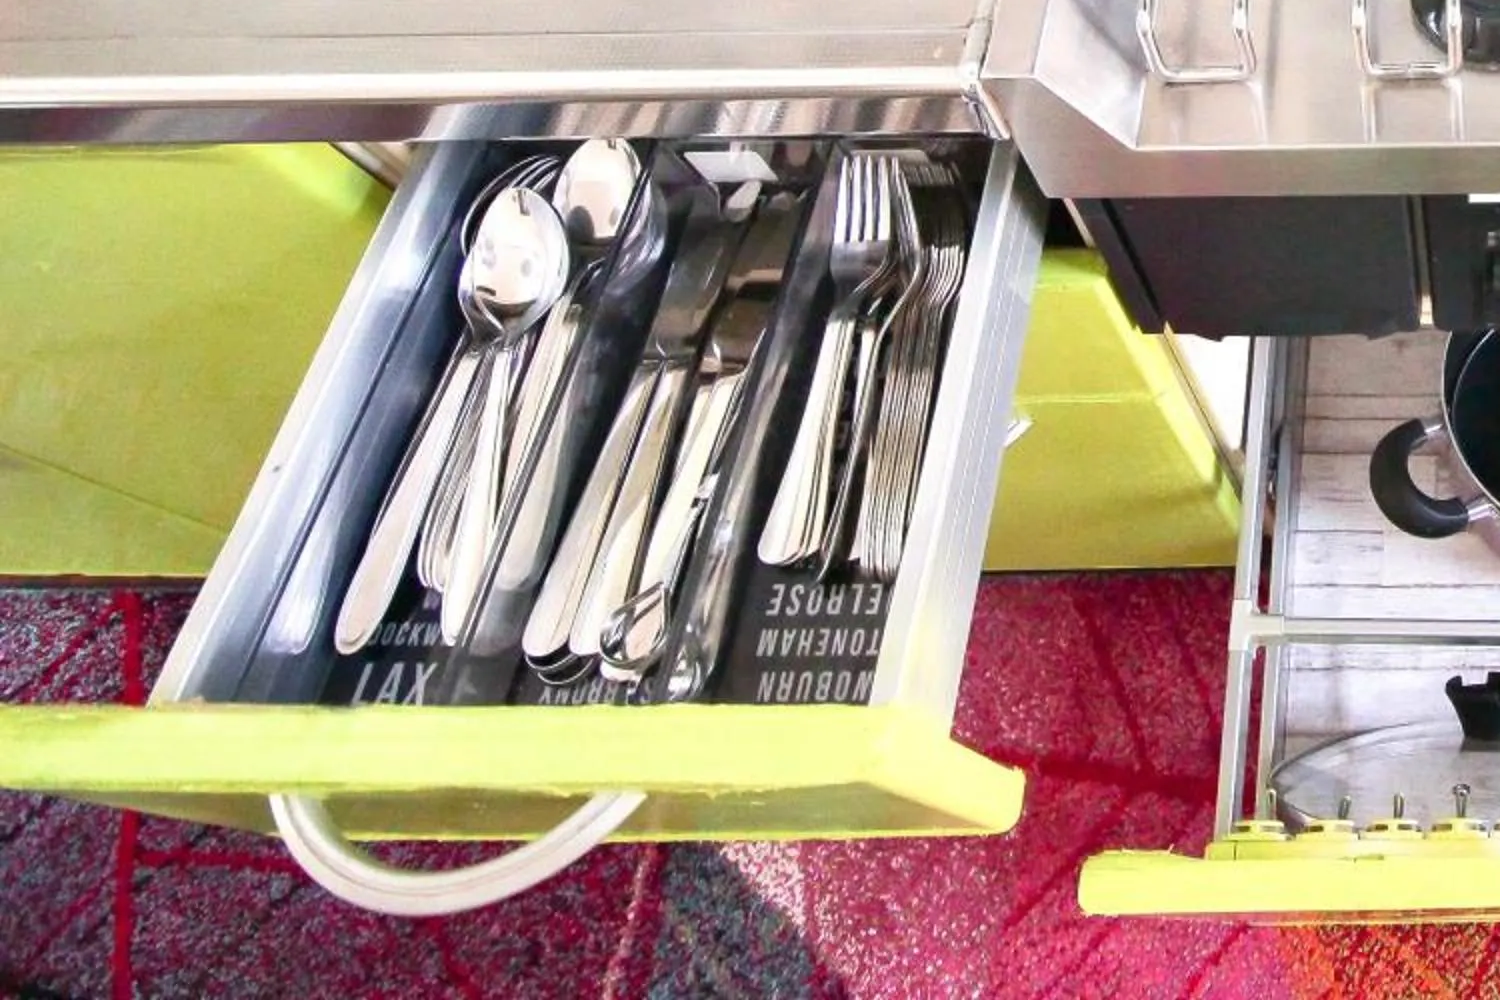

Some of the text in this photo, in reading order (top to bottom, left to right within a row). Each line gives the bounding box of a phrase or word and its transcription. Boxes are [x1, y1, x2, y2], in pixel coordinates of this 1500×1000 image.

[765, 583, 893, 616] ELROSE
[367, 622, 446, 647] DOCKW
[756, 628, 880, 657] TONEHAM
[351, 662, 438, 706] LAX
